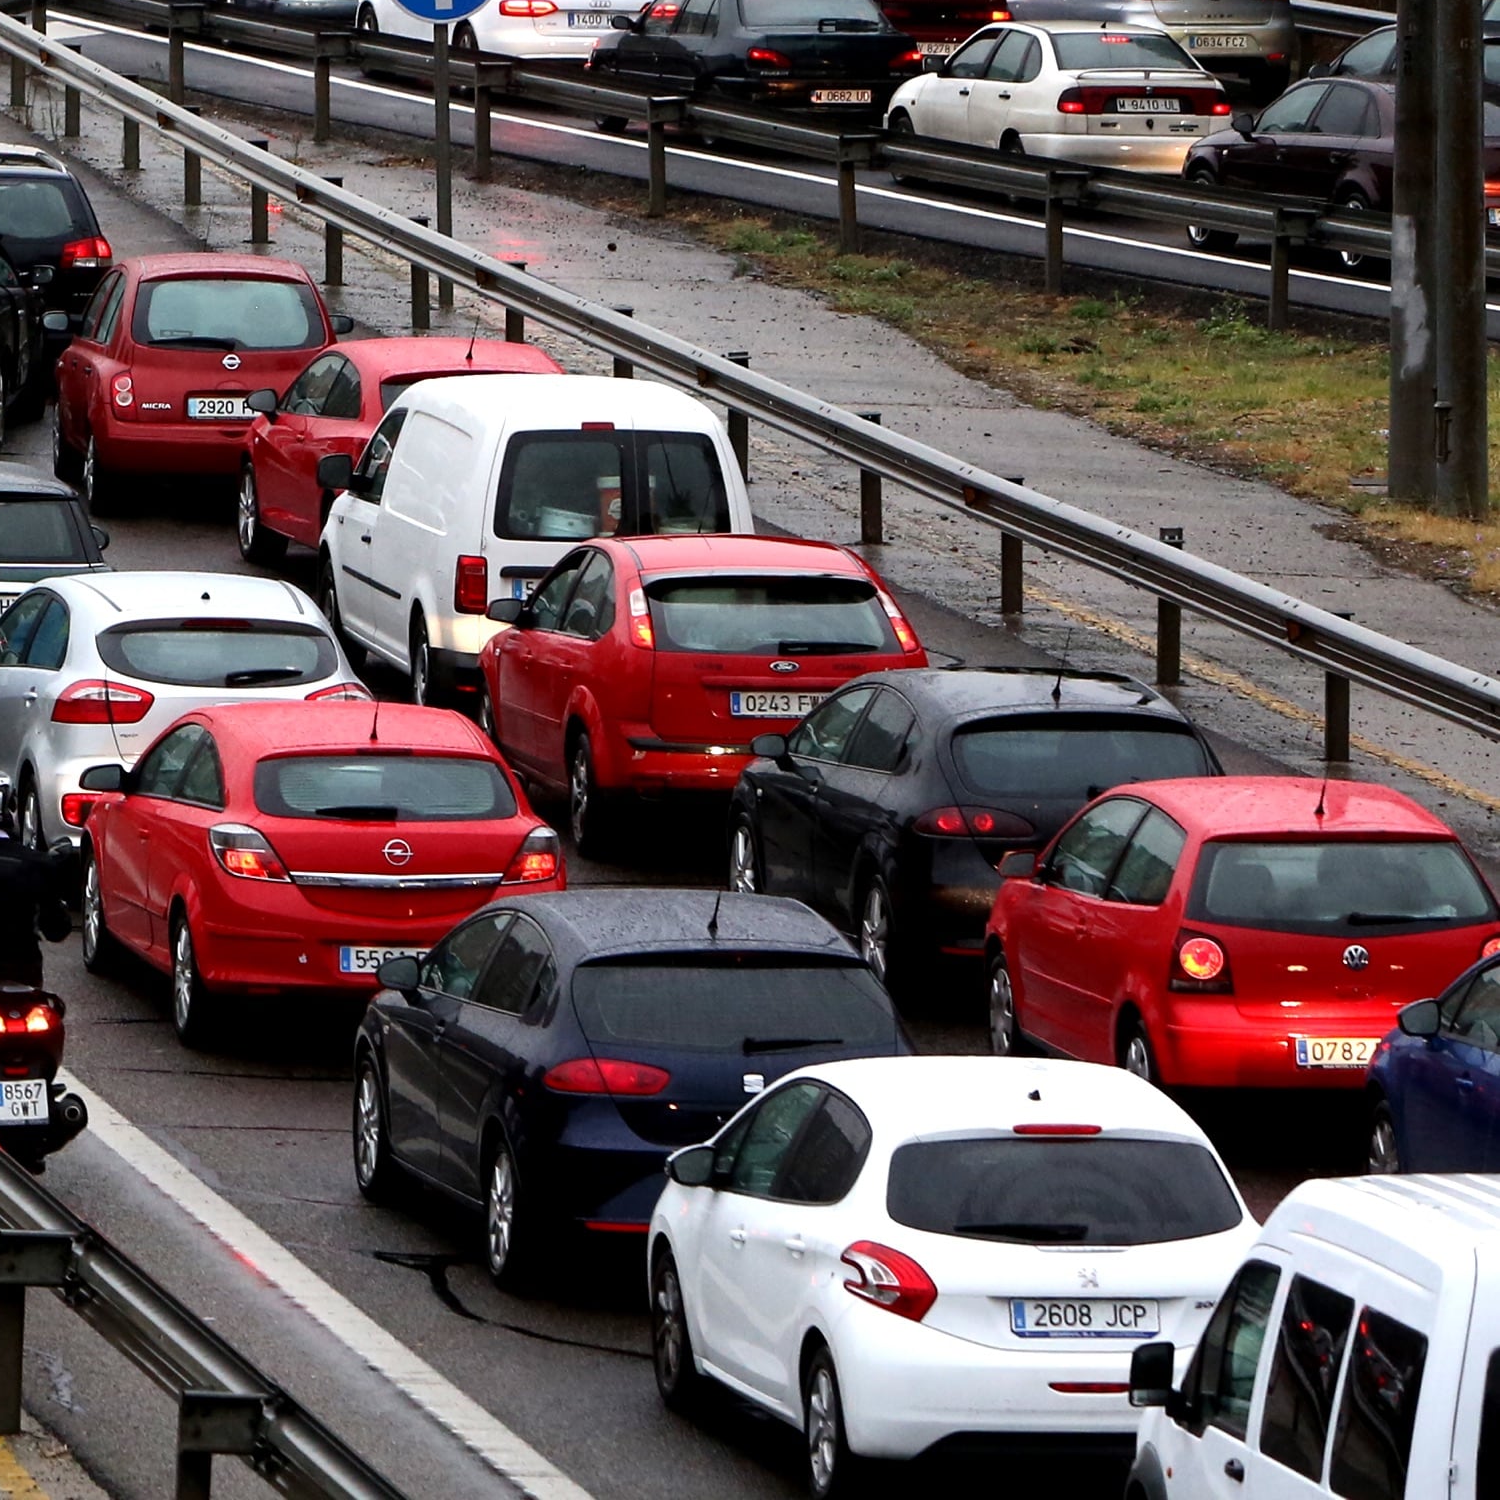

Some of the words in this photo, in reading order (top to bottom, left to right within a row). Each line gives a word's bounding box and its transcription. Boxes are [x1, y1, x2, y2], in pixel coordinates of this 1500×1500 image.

[577, 14, 602, 25] 1400
[141, 402, 172, 410] MICRA
[198, 400, 235, 415] 2920
[745, 693, 791, 713] 0243
[798, 694, 827, 713] FW
[1312, 1042, 1368, 1062] 0782
[5, 1082, 44, 1101] 8567
[11, 1100, 39, 1117] GWT
[1034, 1304, 1092, 1327] 2608
[1104, 1305, 1147, 1329] JCP
